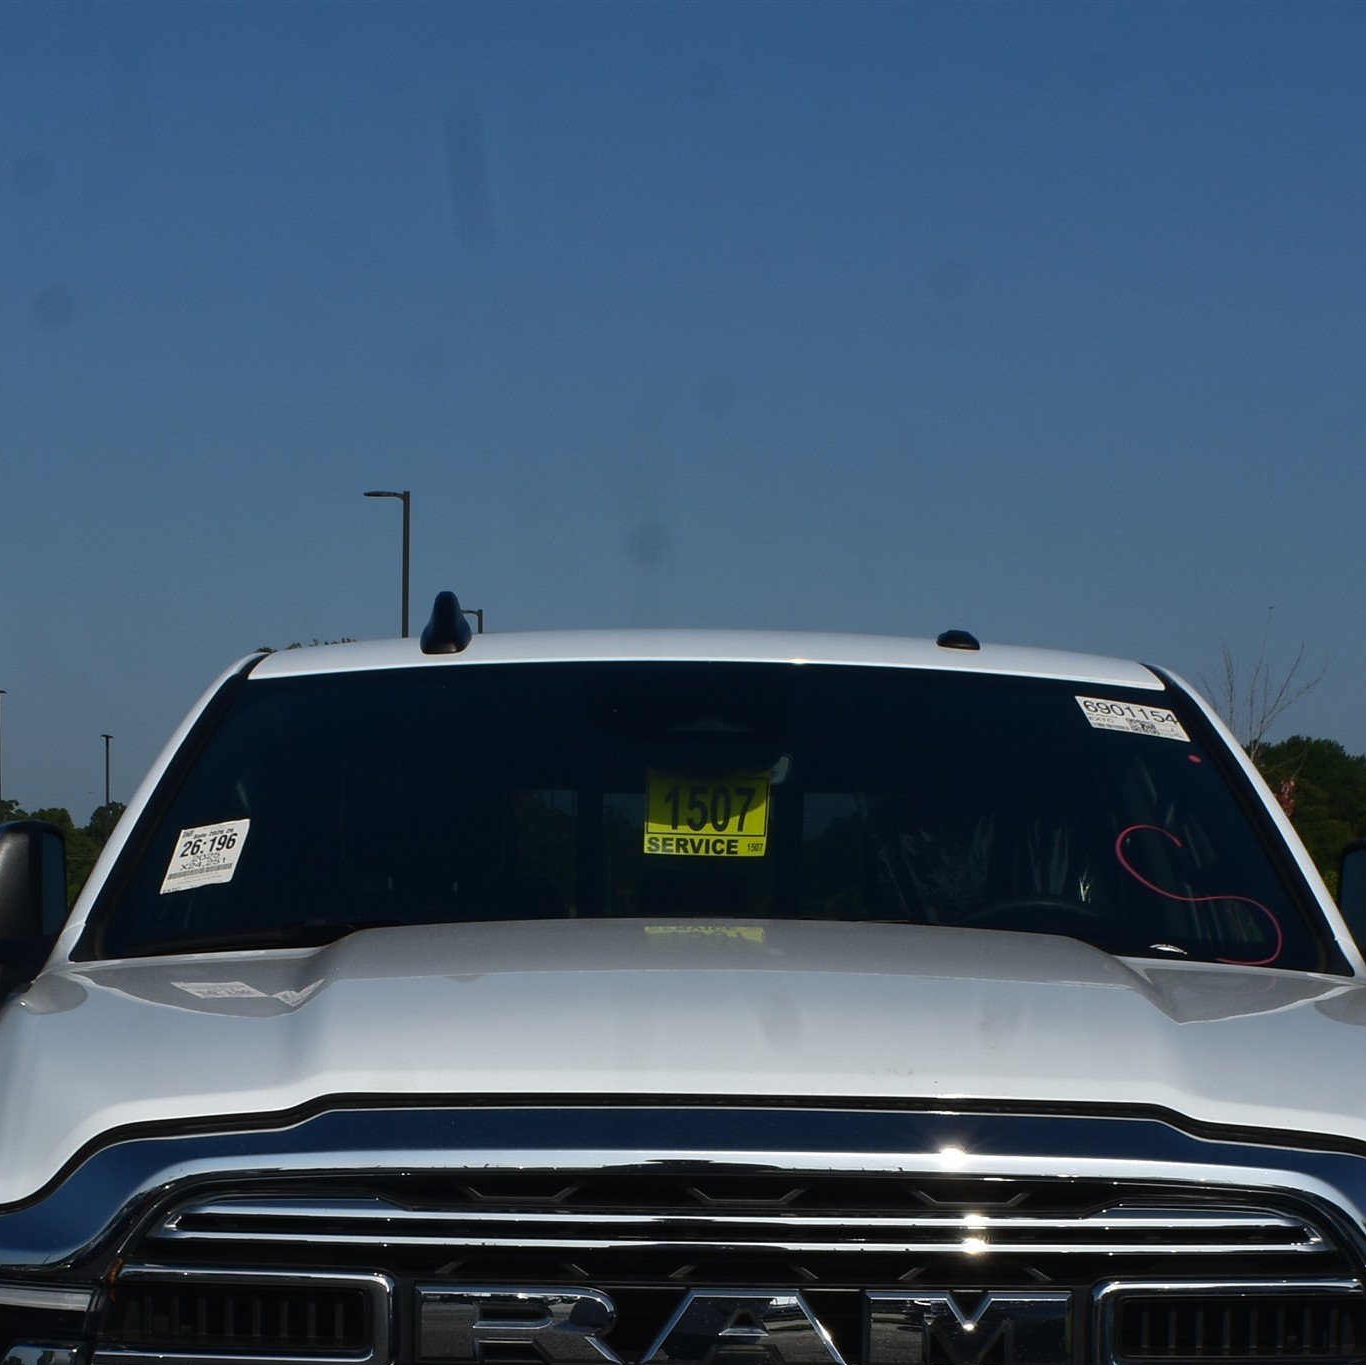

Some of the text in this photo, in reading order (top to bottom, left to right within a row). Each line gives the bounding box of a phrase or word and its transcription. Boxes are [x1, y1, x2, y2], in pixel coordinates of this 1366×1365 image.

[1083, 700, 1179, 726] 6901154
[664, 784, 756, 833] 1507
[180, 833, 238, 857] 26:196
[647, 836, 739, 855] SERVICE
[747, 842, 764, 852] 1507
